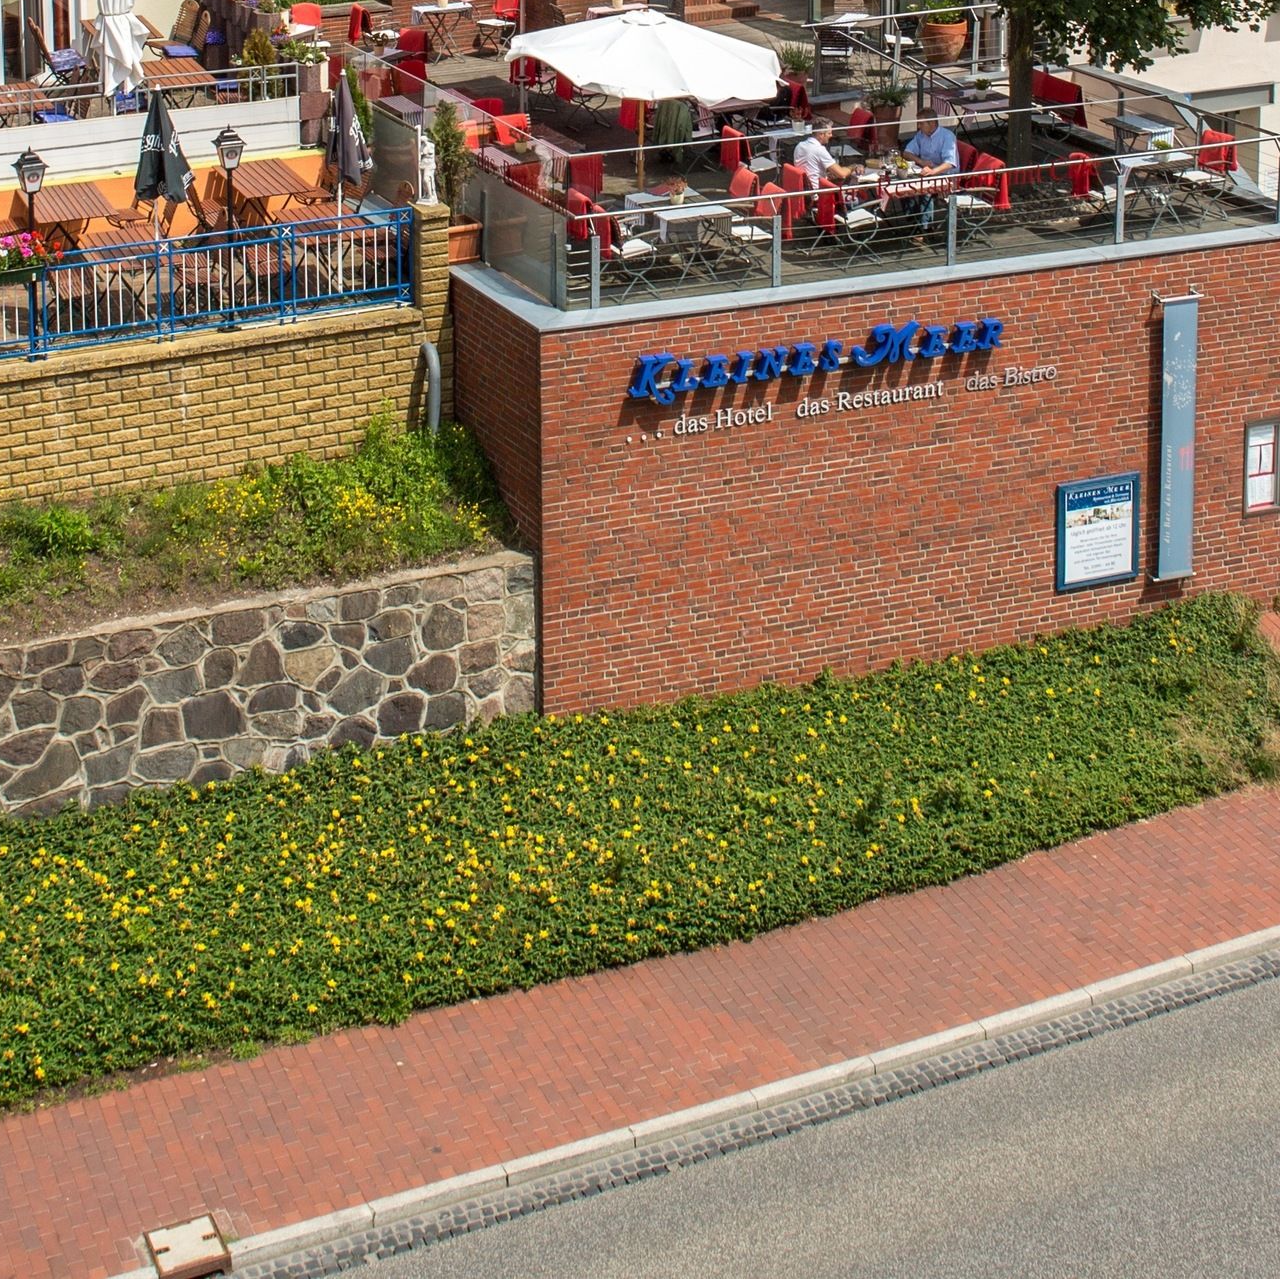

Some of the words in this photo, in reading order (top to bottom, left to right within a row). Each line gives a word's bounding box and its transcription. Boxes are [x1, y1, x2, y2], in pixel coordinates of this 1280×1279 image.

[629, 338, 843, 406] KLEINES
[851, 317, 1004, 368] MEER
[674, 413, 709, 435] das
[715, 401, 773, 429] Hotel
[796, 398, 830, 418] das
[836, 379, 944, 412] Restaurant
[966, 371, 998, 392] das
[1002, 365, 1057, 388] Bistro
